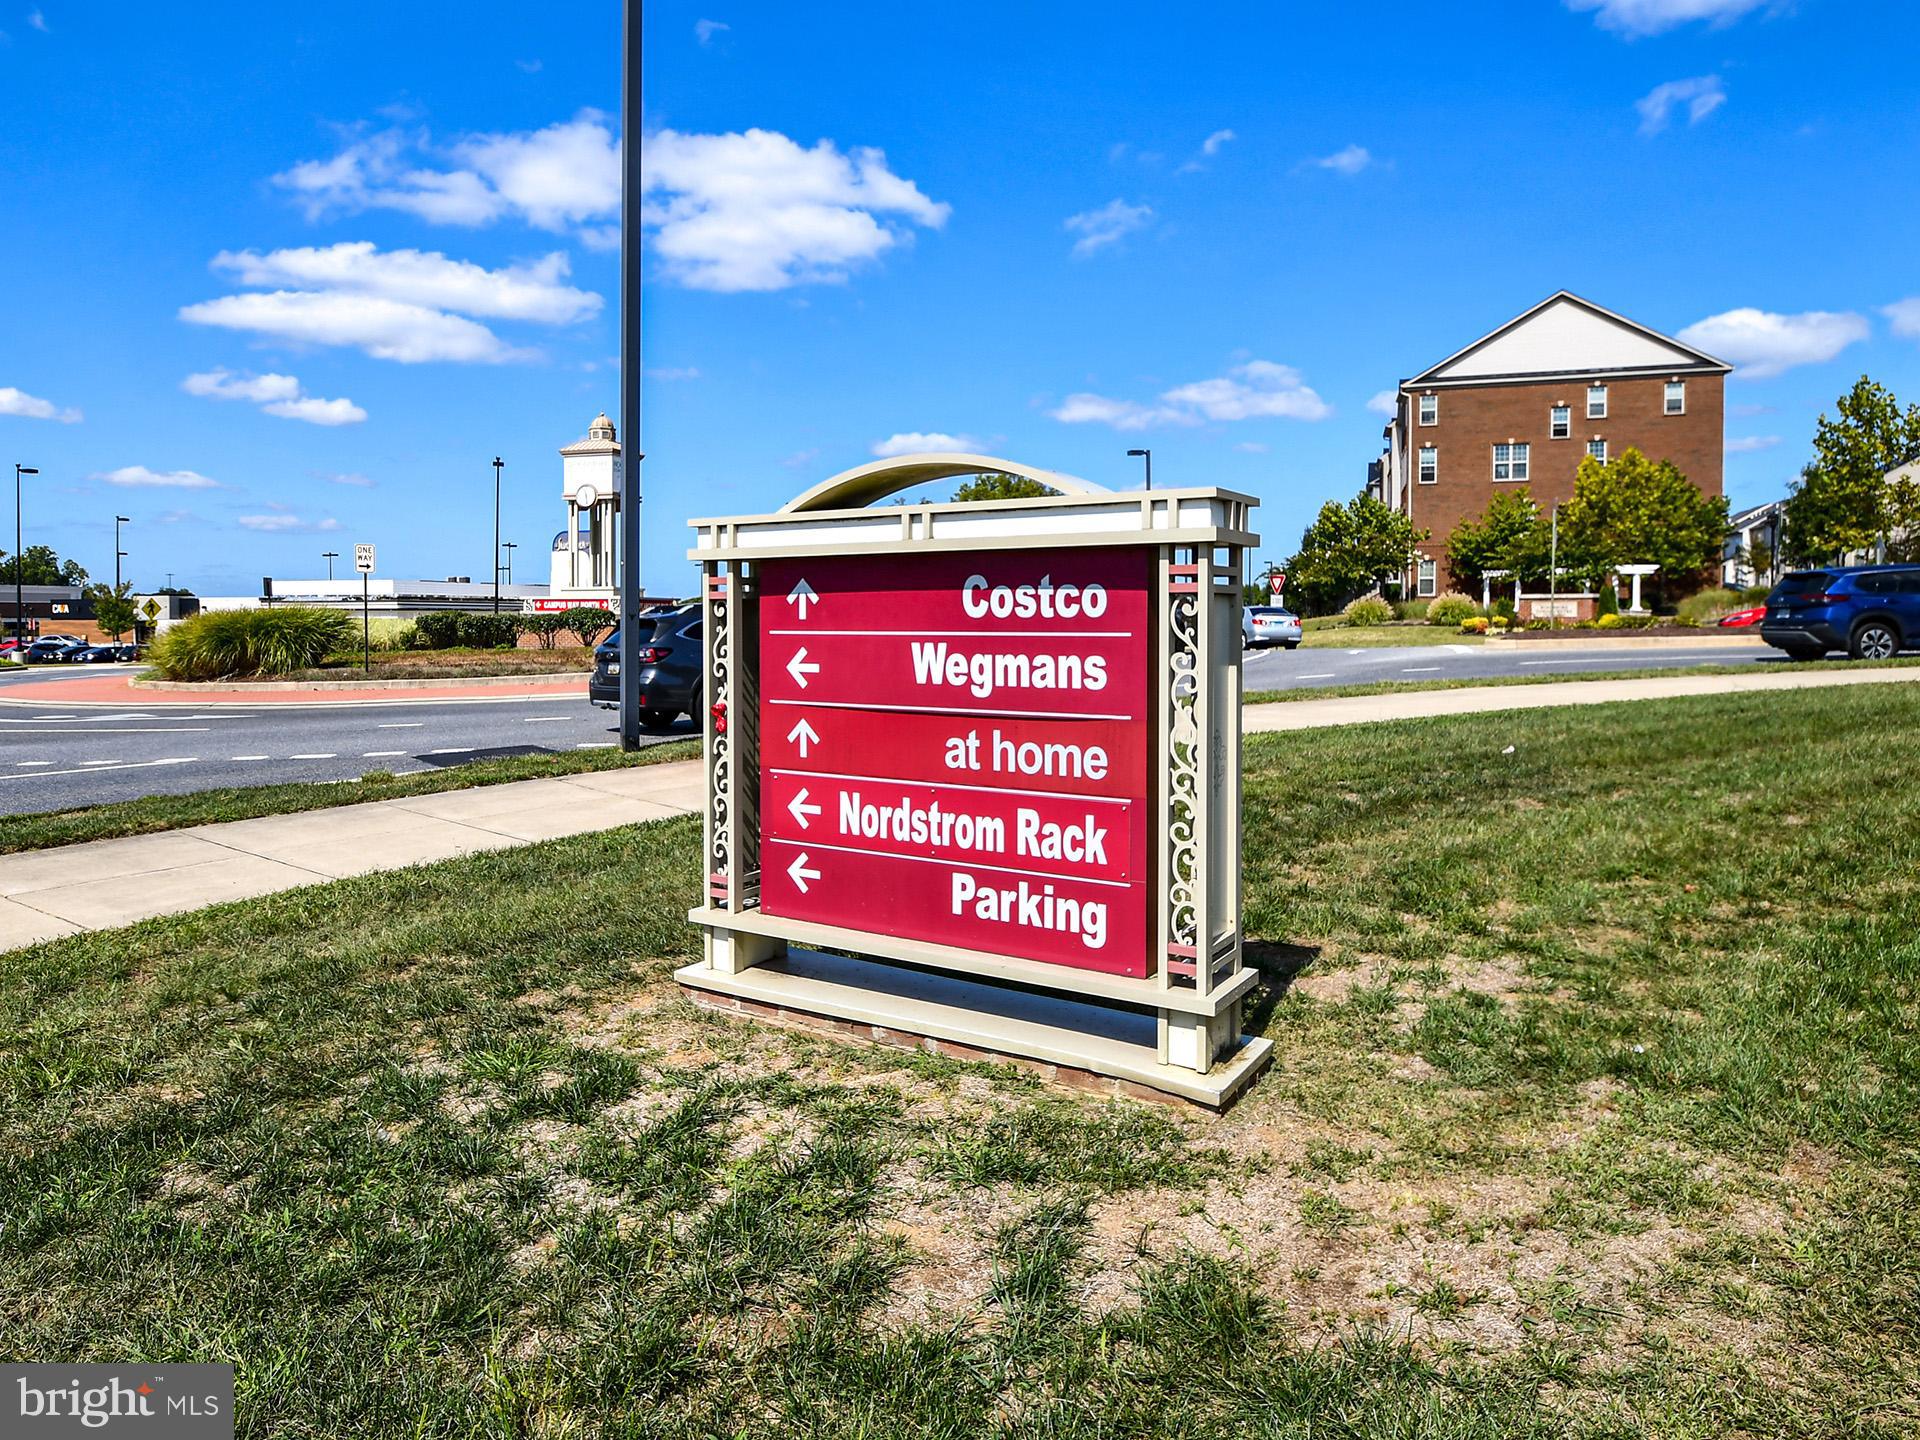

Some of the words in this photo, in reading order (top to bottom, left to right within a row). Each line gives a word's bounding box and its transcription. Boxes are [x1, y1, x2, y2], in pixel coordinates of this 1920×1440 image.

[357, 546, 372, 554] ONE
[962, 574, 1108, 619] Costco
[911, 641, 1108, 699] Wegmans
[944, 729, 981, 771] at
[992, 729, 1109, 781] home
[839, 790, 1005, 853] Nordstrom
[1016, 807, 1108, 865] Rack
[951, 872, 1108, 949] Parking
